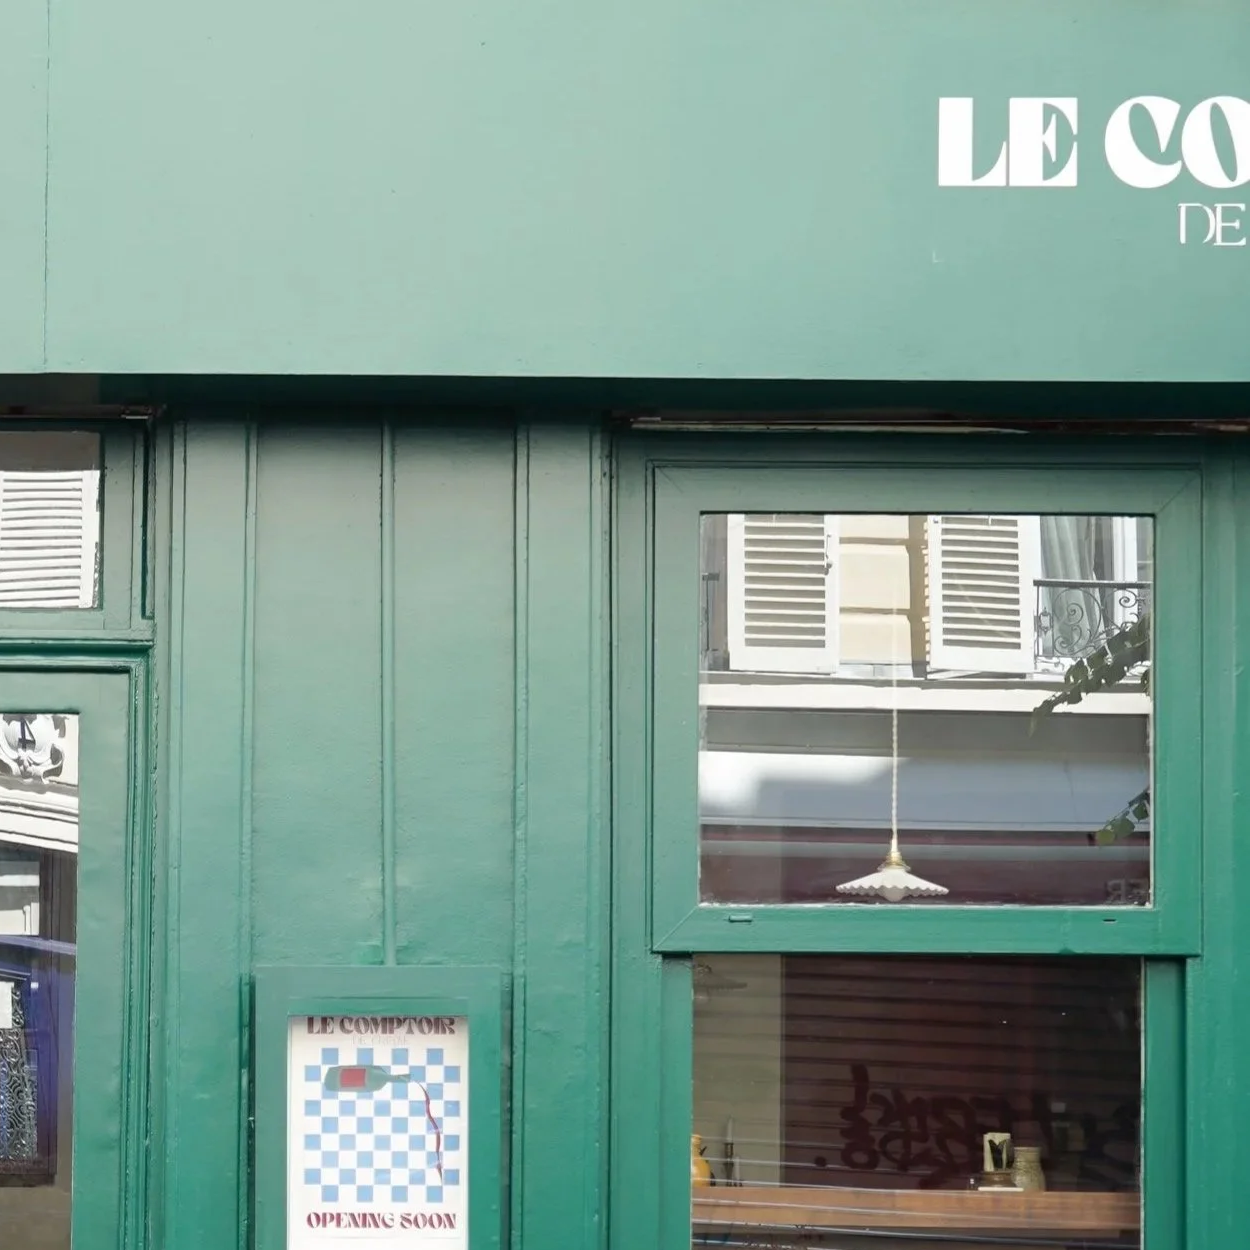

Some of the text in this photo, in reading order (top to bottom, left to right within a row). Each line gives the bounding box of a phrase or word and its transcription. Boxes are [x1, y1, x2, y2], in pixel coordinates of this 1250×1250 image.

[938, 95, 1250, 189] LE CO
[1177, 202, 1247, 246] DE
[307, 1016, 456, 1035] LE COMPTOIR
[306, 1212, 457, 1229] OPENING SOON
